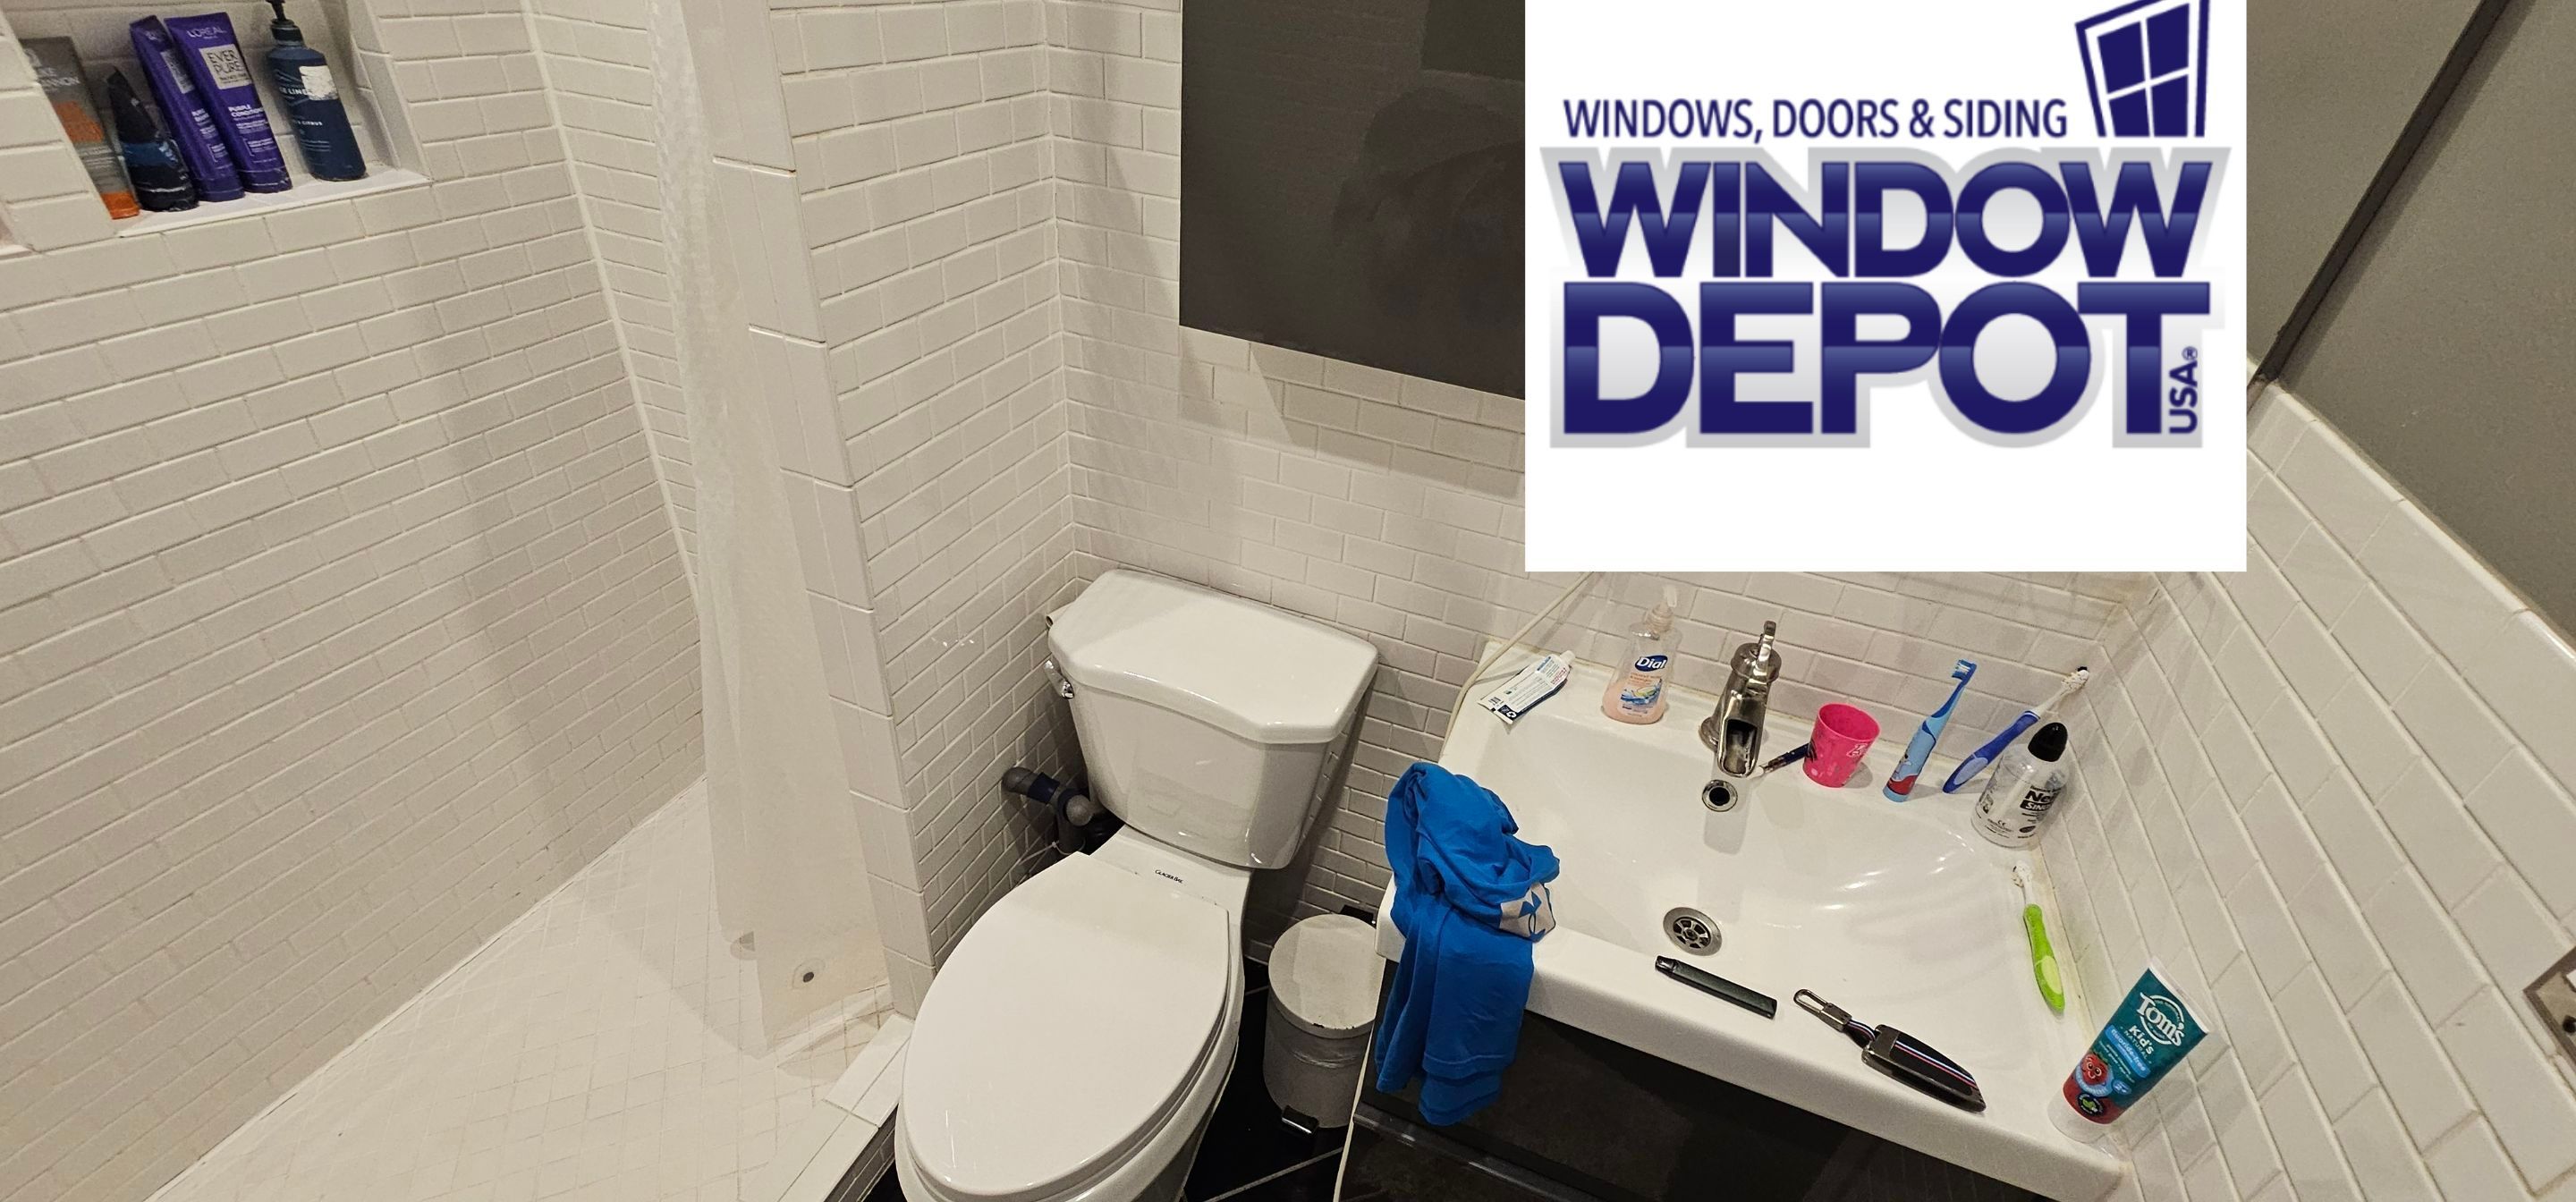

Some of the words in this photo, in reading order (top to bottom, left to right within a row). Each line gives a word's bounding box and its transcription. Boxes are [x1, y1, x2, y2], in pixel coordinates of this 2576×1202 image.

[207, 49, 239, 63] EVER
[213, 60, 246, 76] PURE
[1636, 656, 1667, 670] Dial
[2136, 991, 2185, 1047] Tom's
[2123, 1029, 2148, 1061] NATURAL
[2128, 1024, 2155, 1055] Kid's
